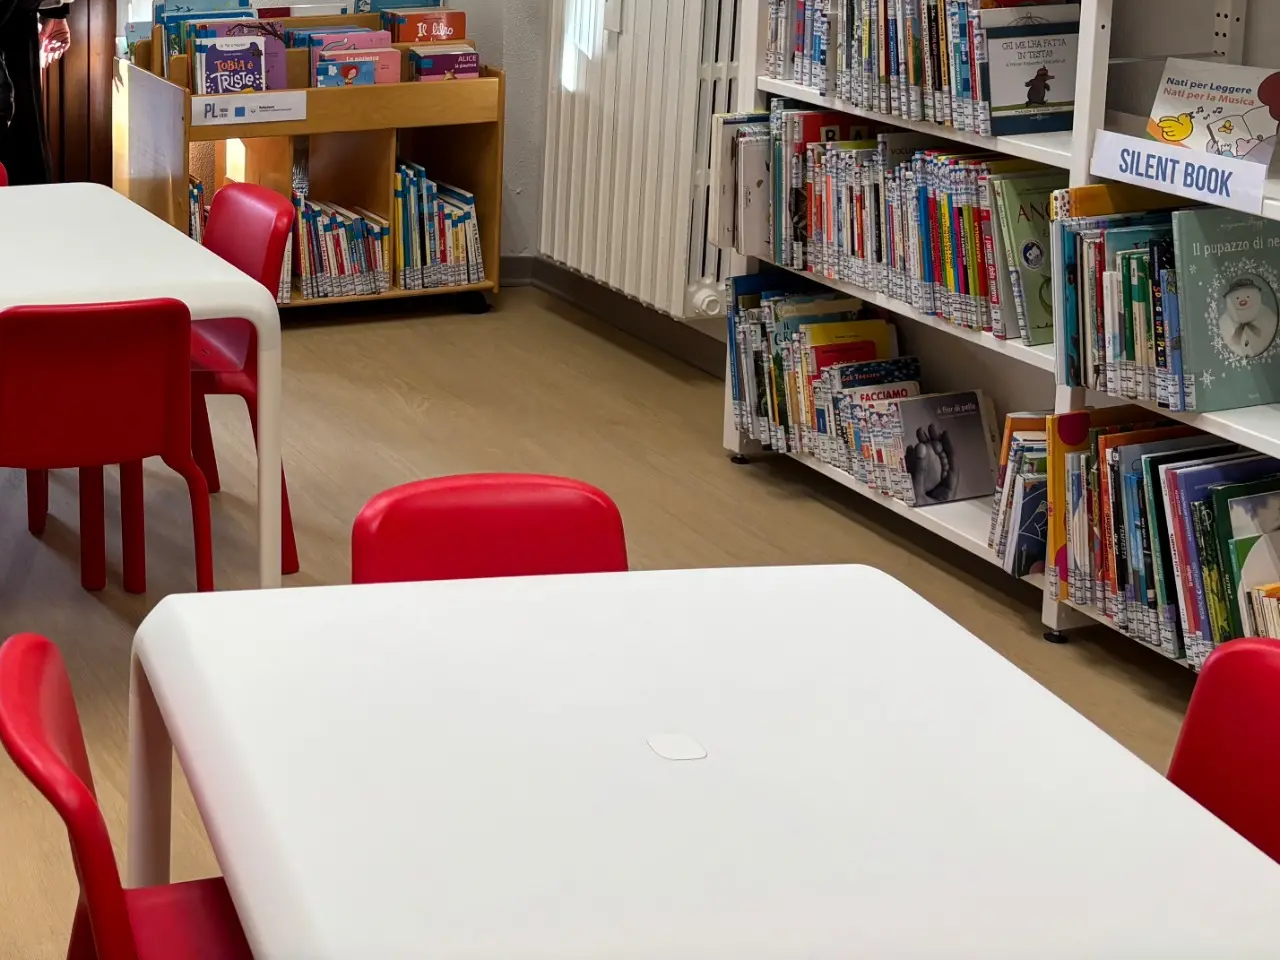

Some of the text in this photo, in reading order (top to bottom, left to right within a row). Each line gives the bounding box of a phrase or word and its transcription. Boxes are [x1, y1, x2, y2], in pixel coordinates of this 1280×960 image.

[432, 23, 453, 39] libro
[1166, 77, 1252, 95] Nati per Leggere
[1163, 87, 1255, 107] Nati per la Musica
[1119, 148, 1233, 198] SILENT BOOK
[1193, 243, 1200, 256] Il
[1204, 240, 1248, 258] pupazzo
[1253, 237, 1265, 249] di
[860, 388, 908, 401] FACCIAMO
